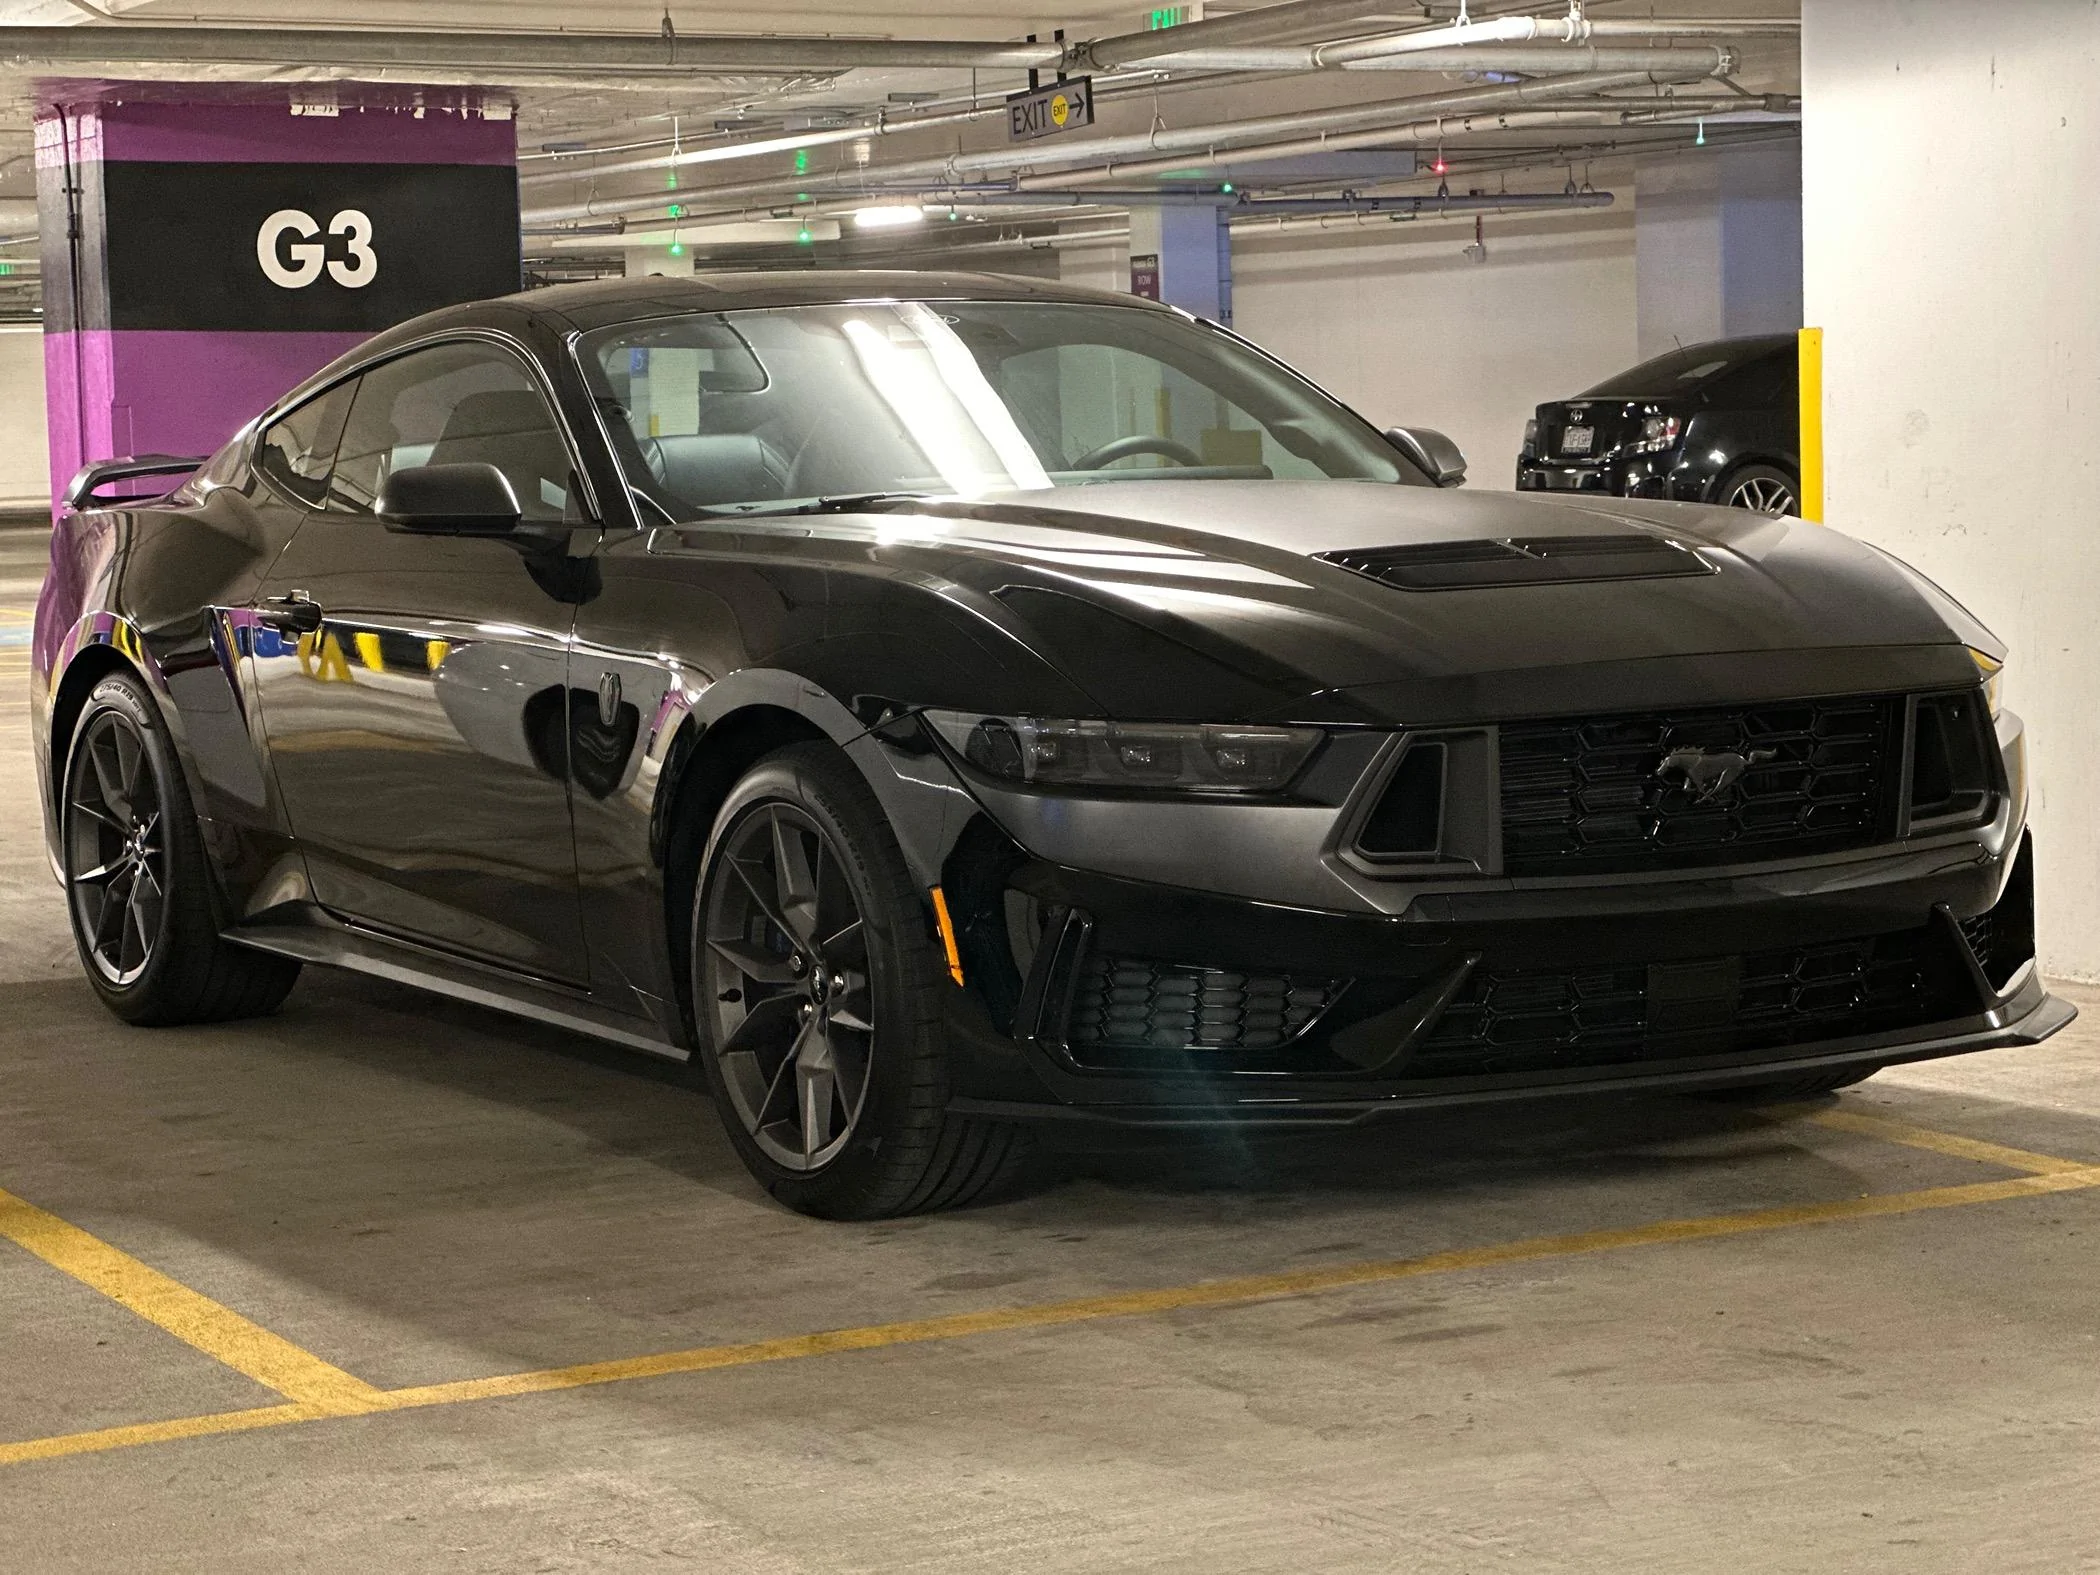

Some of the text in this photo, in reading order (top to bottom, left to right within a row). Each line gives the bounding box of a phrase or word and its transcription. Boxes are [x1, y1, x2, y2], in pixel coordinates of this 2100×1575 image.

[1012, 99, 1048, 135] EXIT
[1053, 103, 1066, 116] EXIT
[256, 209, 378, 289] G3
[121, 688, 133, 700] R19
